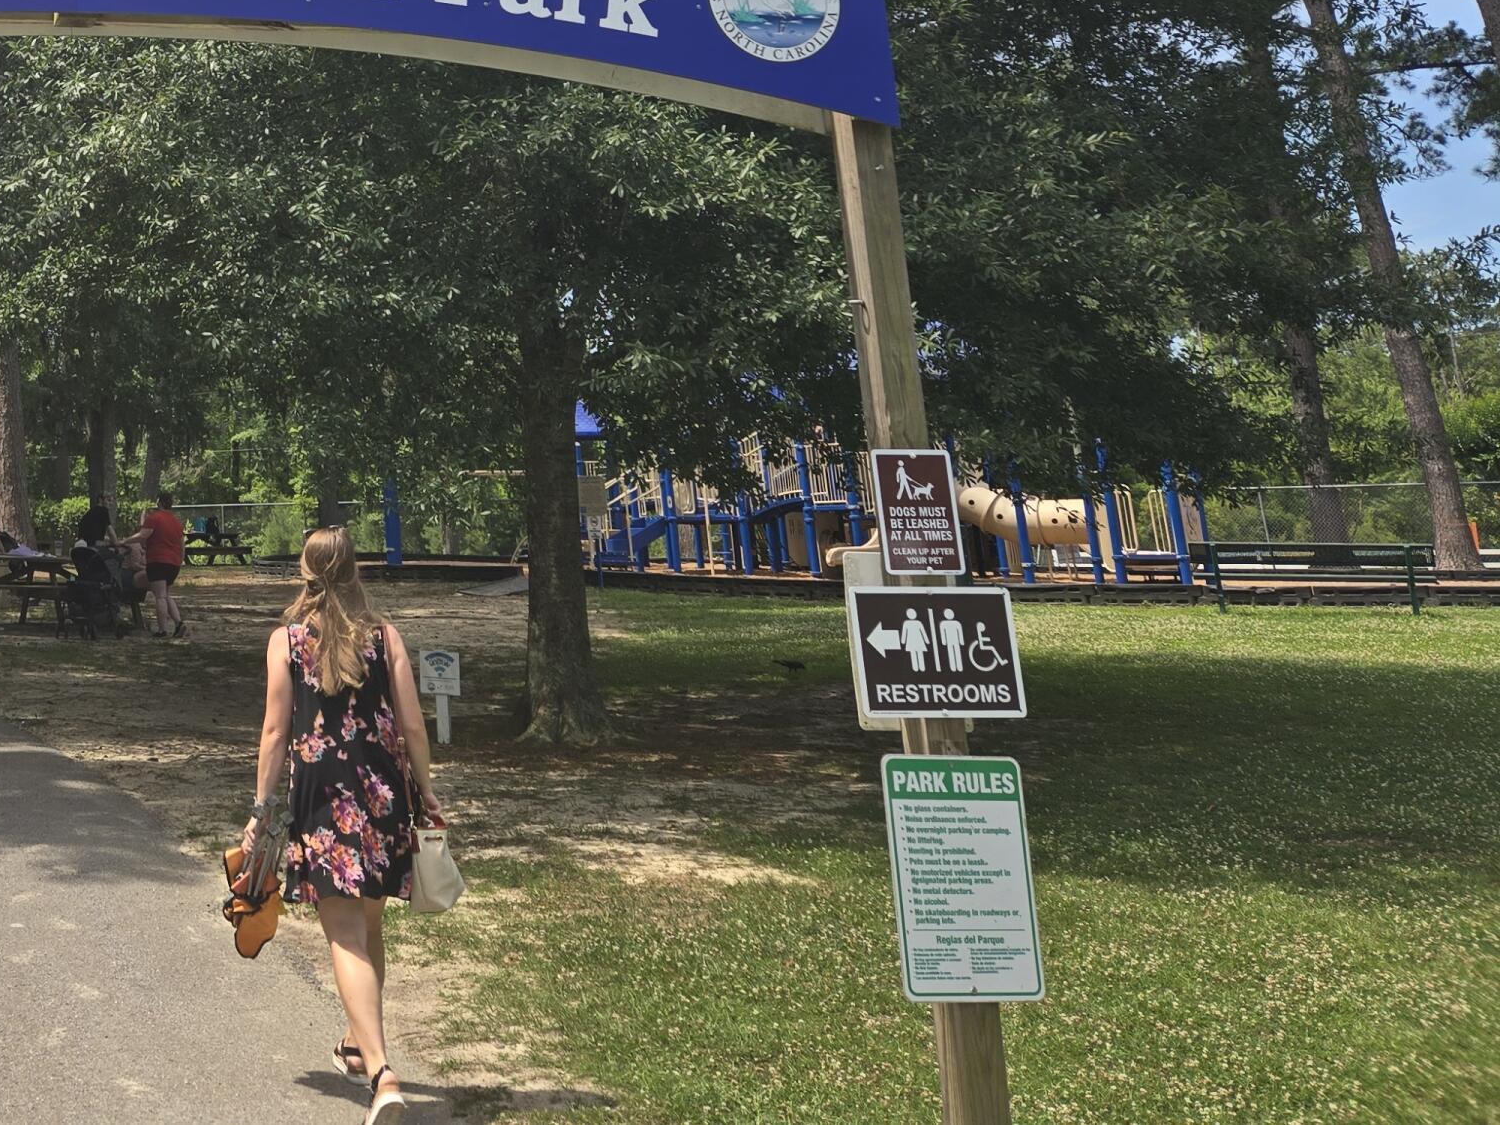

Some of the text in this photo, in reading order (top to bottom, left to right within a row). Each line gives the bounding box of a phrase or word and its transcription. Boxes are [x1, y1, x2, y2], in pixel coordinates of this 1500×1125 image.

[716, 10, 838, 60] NORTH CAROLINA
[889, 507, 946, 517] DOGS MUST
[890, 519, 949, 529] BE LEASHED
[891, 531, 953, 541] AT ALL TIMES
[893, 548, 917, 556] CLEAN
[930, 548, 954, 556] AFTER
[929, 556, 943, 564] PET
[876, 684, 1011, 703] RESTROOMS
[892, 770, 1015, 795] PARK RULES
[916, 826, 947, 834] overnight
[948, 827, 972, 835] parking
[917, 837, 945, 845] littering.
[908, 847, 933, 855] Hunting
[982, 869, 1003, 877] except
[948, 877, 972, 885] parking
[925, 909, 971, 917] skateboarding
[916, 917, 941, 925] parking
[936, 935, 1004, 946] Reglas del Parque
